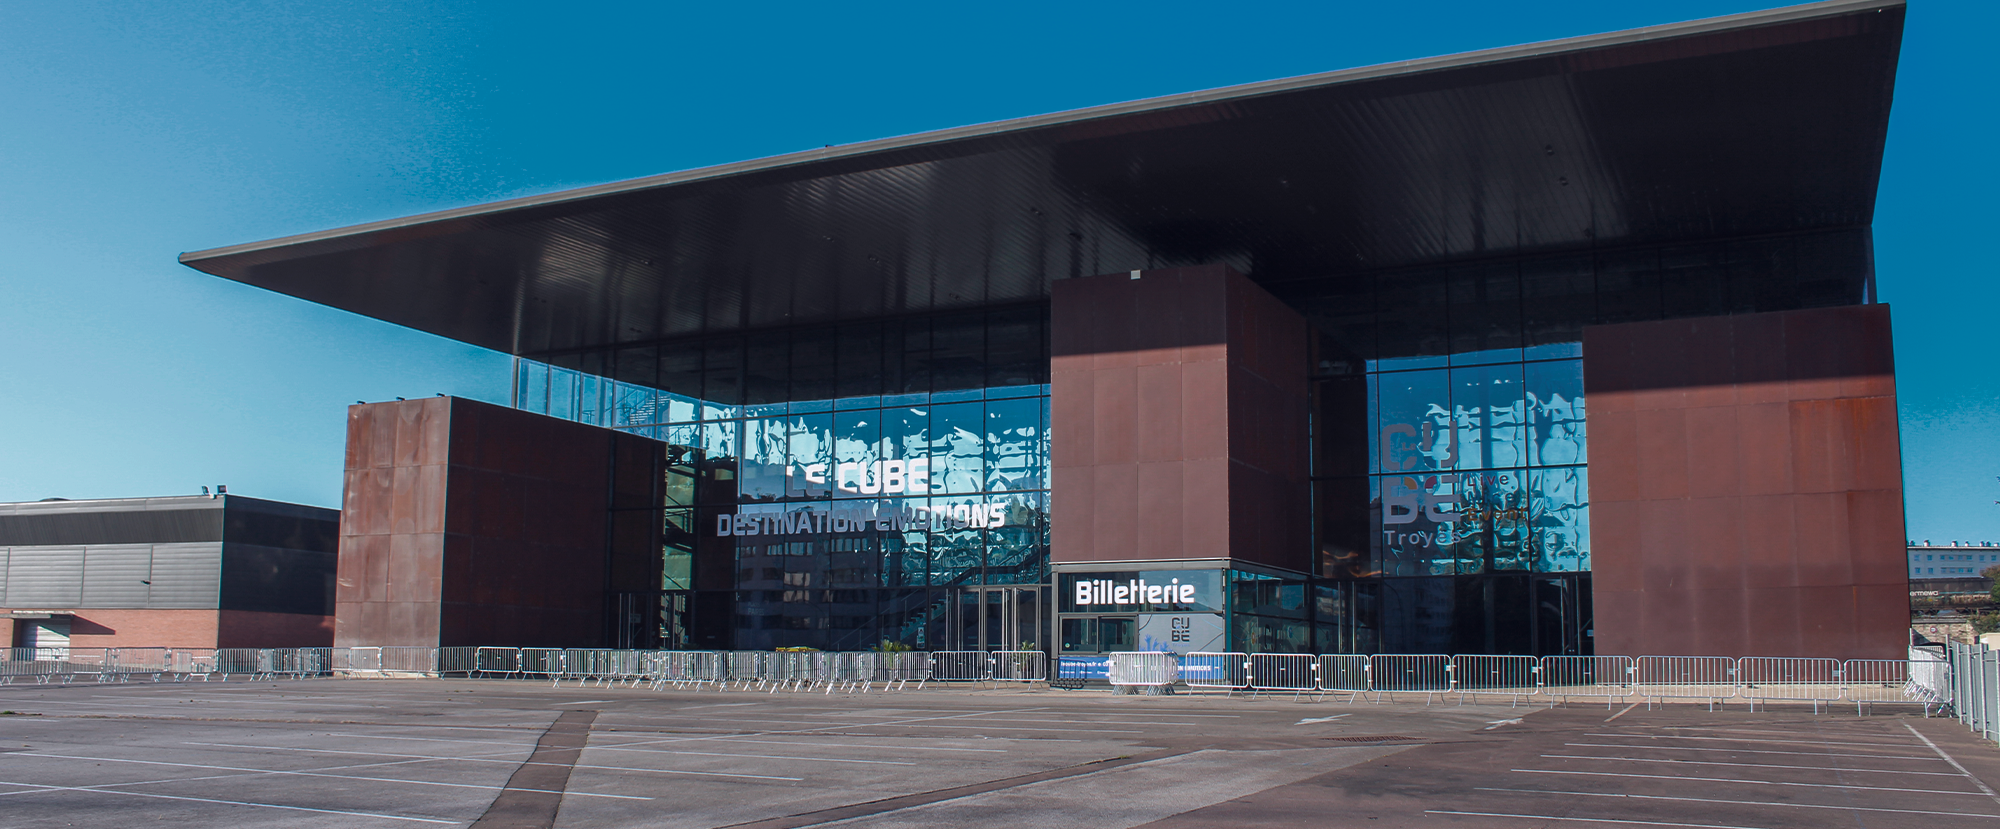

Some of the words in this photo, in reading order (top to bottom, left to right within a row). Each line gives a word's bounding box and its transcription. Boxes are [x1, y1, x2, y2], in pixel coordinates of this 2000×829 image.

[786, 464, 825, 498] LE
[838, 458, 928, 494] CUBE
[1467, 472, 1509, 487] Live
[717, 509, 865, 536] DESTINATION
[875, 503, 1005, 531] EMOTIONS
[1468, 507, 1526, 521] Event
[1384, 530, 1462, 548] Troyes
[1076, 578, 1195, 605] Billetterie
